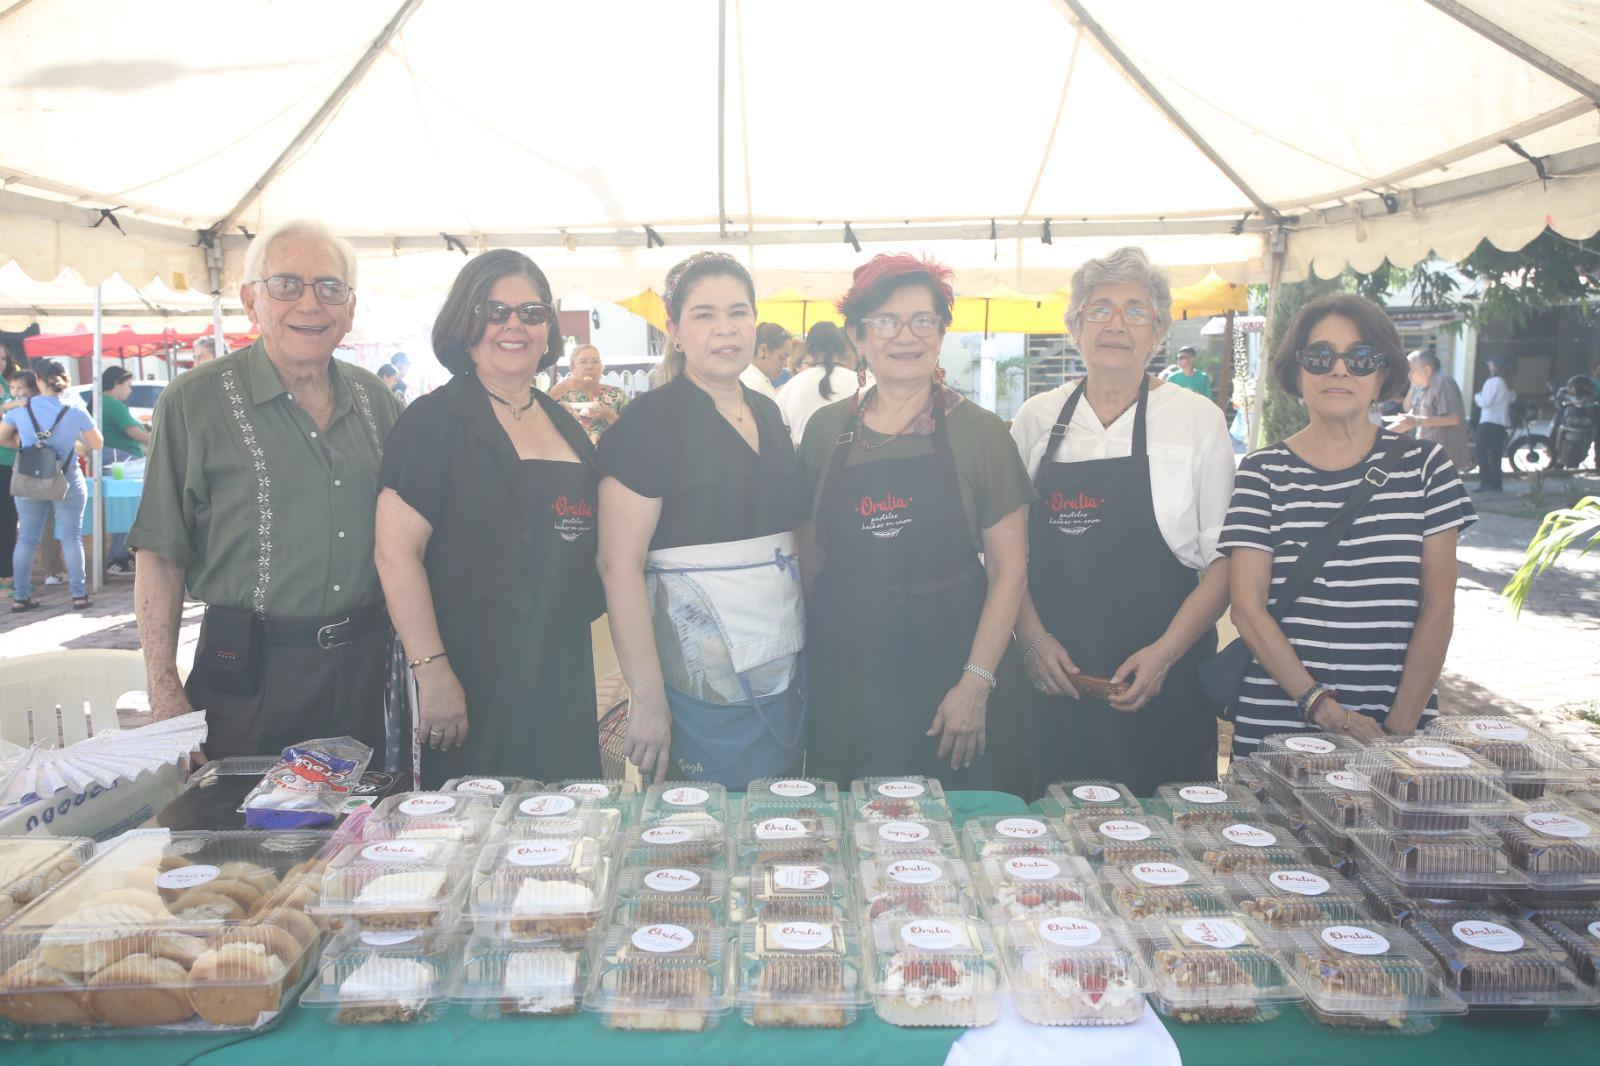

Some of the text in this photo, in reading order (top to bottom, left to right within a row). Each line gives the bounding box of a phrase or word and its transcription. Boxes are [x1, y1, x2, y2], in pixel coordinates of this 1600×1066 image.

[555, 496, 593, 516] Oralia
[861, 493, 908, 516] Oralia
[1052, 492, 1099, 511] Oralia
[1476, 722, 1513, 731] Oralia
[1416, 748, 1457, 757] Oralia
[469, 781, 497, 791] Oralia
[410, 798, 446, 806] Oralia
[1531, 818, 1569, 826] Oralia
[765, 823, 797, 832] Oralia
[1229, 829, 1263, 837] Oralia
[373, 845, 415, 853] Oralia
[518, 846, 558, 855] Oralia
[656, 872, 691, 881] Oralia
[1278, 874, 1317, 883] Oralia
[910, 926, 949, 934] Oralia
[1048, 923, 1088, 931] Oralia
[1460, 927, 1503, 936] Oralia
[647, 927, 684, 942] Oralia
[782, 927, 822, 937] Oralia
[1329, 931, 1374, 940] Oralia
